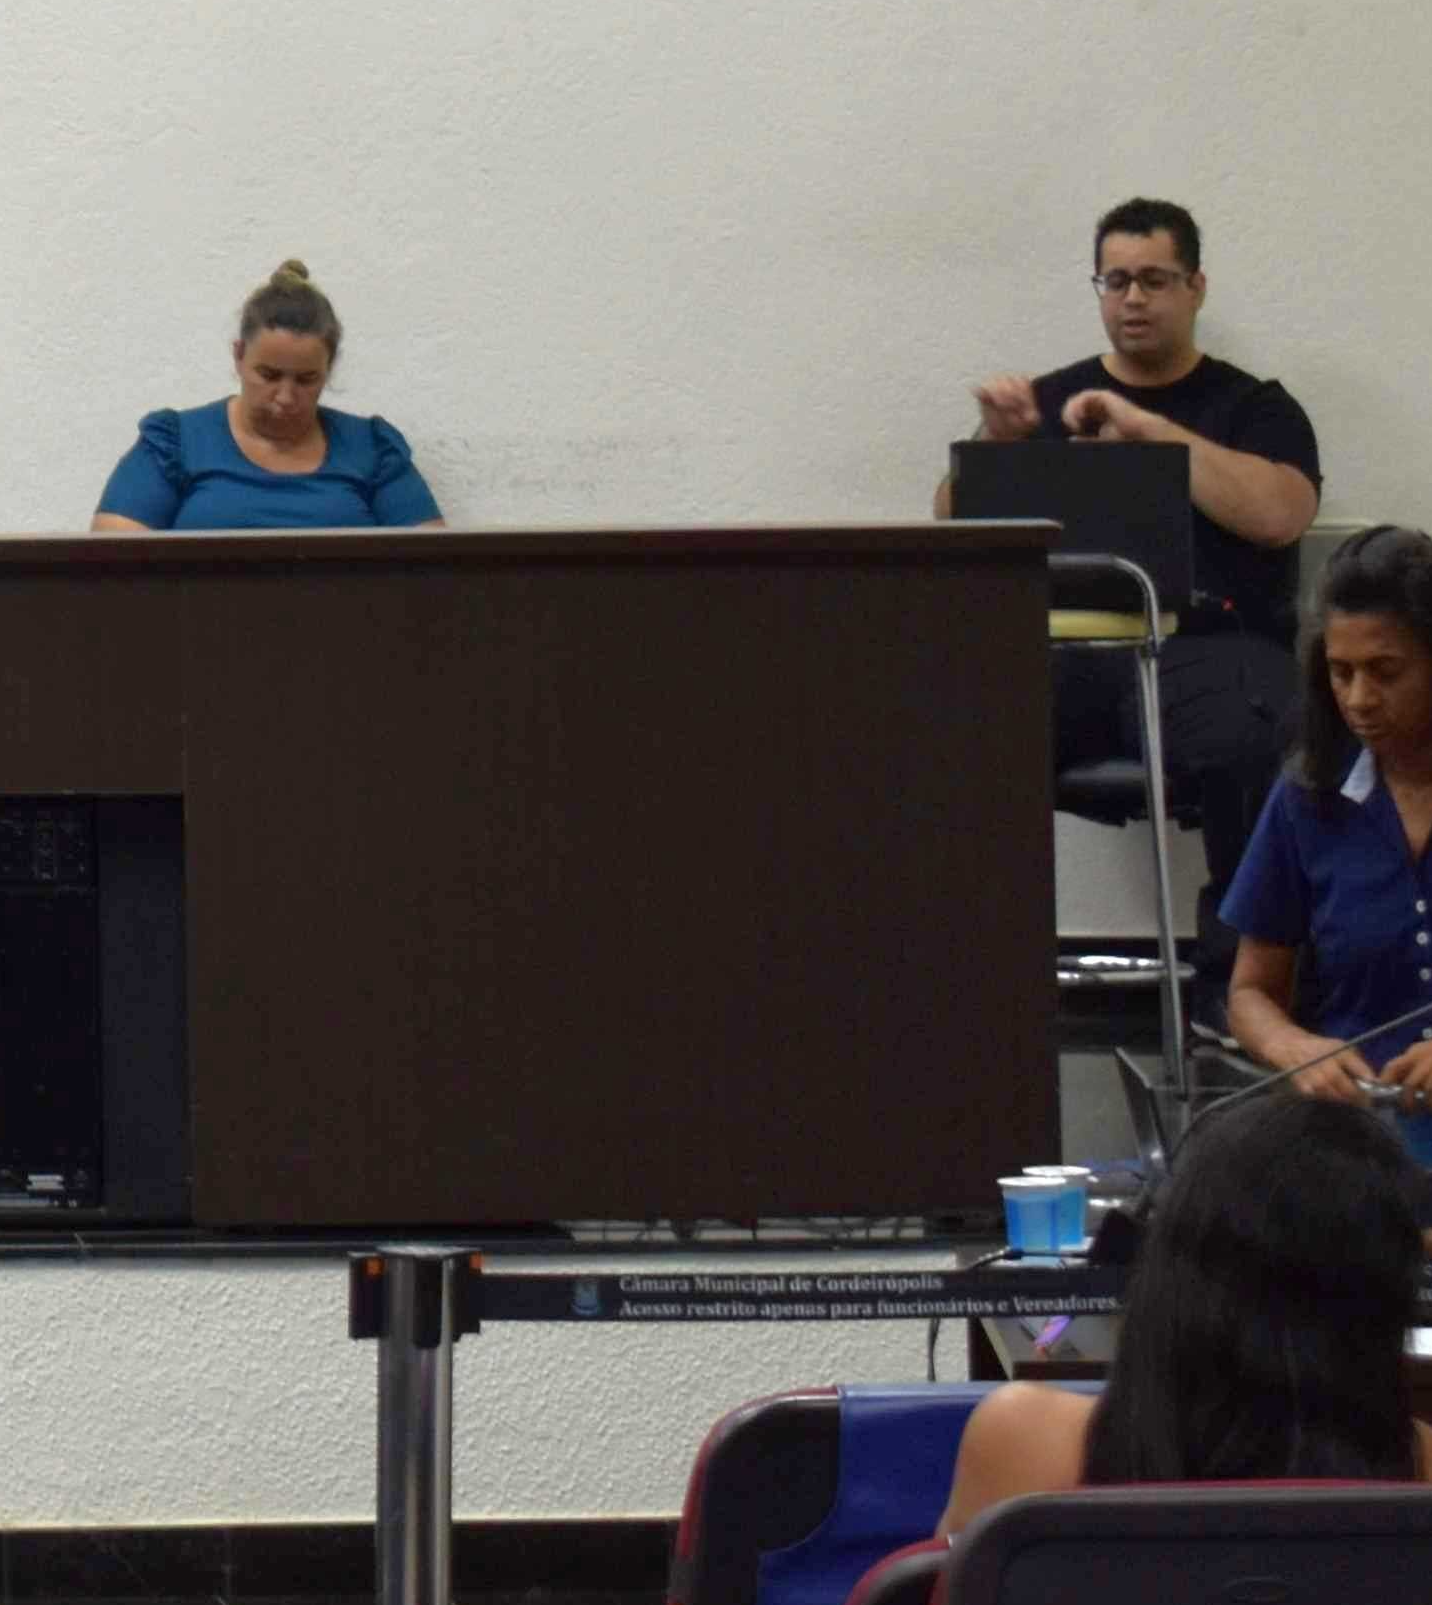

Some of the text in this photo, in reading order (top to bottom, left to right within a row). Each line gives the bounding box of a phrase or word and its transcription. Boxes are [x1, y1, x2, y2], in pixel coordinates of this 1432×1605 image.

[619, 1273, 944, 1296] Câmara Municipal de Cordeirópolis
[618, 1298, 683, 1316] Acesso
[687, 1297, 756, 1316] restrito
[759, 1301, 827, 1319] apenas
[830, 1301, 873, 1319] para
[877, 1297, 993, 1316] funcionários
[997, 1300, 1008, 1313] e
